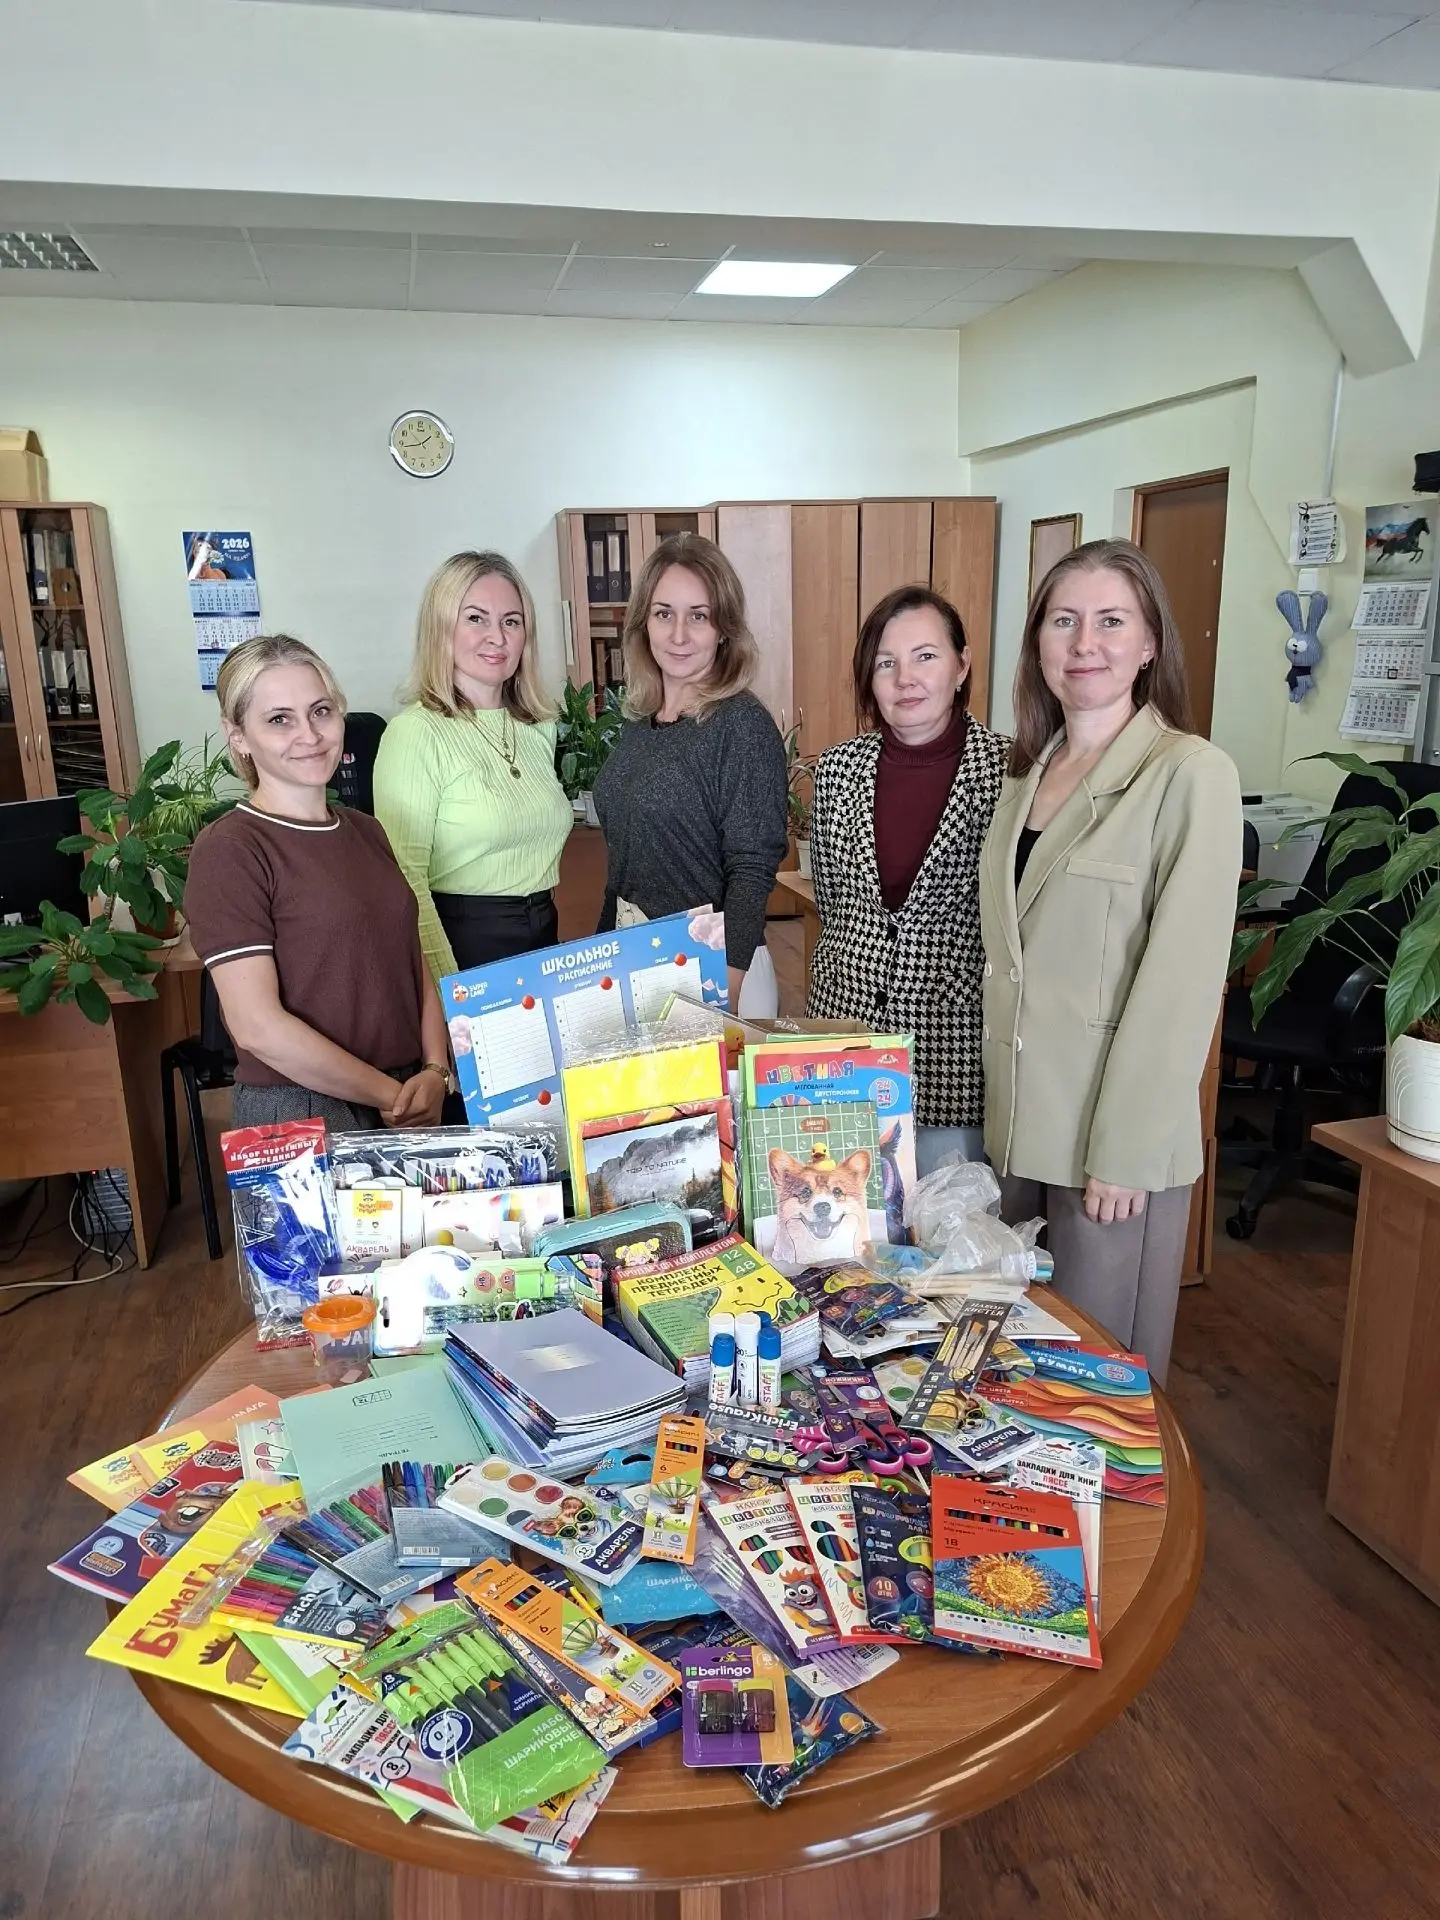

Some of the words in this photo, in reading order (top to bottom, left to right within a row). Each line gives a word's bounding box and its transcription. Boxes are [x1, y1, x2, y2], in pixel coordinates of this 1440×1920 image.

[222, 538, 249, 549] 2026
[541, 941, 620, 976] ШКОЛЬНОЕ
[558, 960, 613, 984] РАСПИСАНИЕ
[766, 1060, 855, 1084] ЦВЕТНАЯ
[231, 1150, 260, 1162] НАБОР
[256, 1152, 296, 1165] СРЕДНИЙ
[656, 1158, 687, 1170] NATURE
[346, 1245, 389, 1254] АКВАРЕЛЬ
[674, 1237, 737, 1267] КОМПЛЕКТОМ
[722, 1249, 742, 1261] 12
[735, 1260, 756, 1274] 48
[631, 1266, 724, 1294] ПРЕДМЕТНЫХ
[637, 1263, 707, 1285] КОМПЛЕКТ
[647, 1276, 718, 1298] ТЕТРАДЕЙ
[964, 1307, 1005, 1317] КИСТЕЙ
[970, 1302, 1004, 1310] НАБОР
[1038, 1357, 1096, 1379] БУМАГА
[716, 1380, 725, 1402] TAFF
[763, 1374, 772, 1403] STAFF
[990, 1397, 1025, 1405] ПАЛИТРА
[709, 1402, 799, 1431] ErichKrause
[970, 1429, 1018, 1454] АКВАРЕЛЬ
[378, 1449, 410, 1458] ТЕТРАДЬ
[1017, 1459, 1056, 1476] ЗАКЛАДКИ
[1059, 1470, 1075, 1481] ДЛЯ
[1078, 1475, 1098, 1487] КНИГ
[735, 1498, 771, 1510] НАБОР
[594, 1526, 636, 1567] АКВАРЕЛЬ
[945, 1538, 958, 1546] 18
[581, 1548, 588, 1556] 12
[647, 1576, 690, 1588] ШАРИКО
[876, 1580, 892, 1590] 10
[540, 1625, 548, 1634] 6
[699, 1666, 751, 1677] berlingo
[385, 1674, 396, 1683] 8
[513, 1690, 534, 1704] СИНИЕ
[513, 1694, 542, 1712] ЧЕРНИЛА
[534, 1714, 565, 1736] НАБО
[341, 1725, 377, 1764] ЗАКЛАДКИ
[386, 1762, 399, 1770] 8
